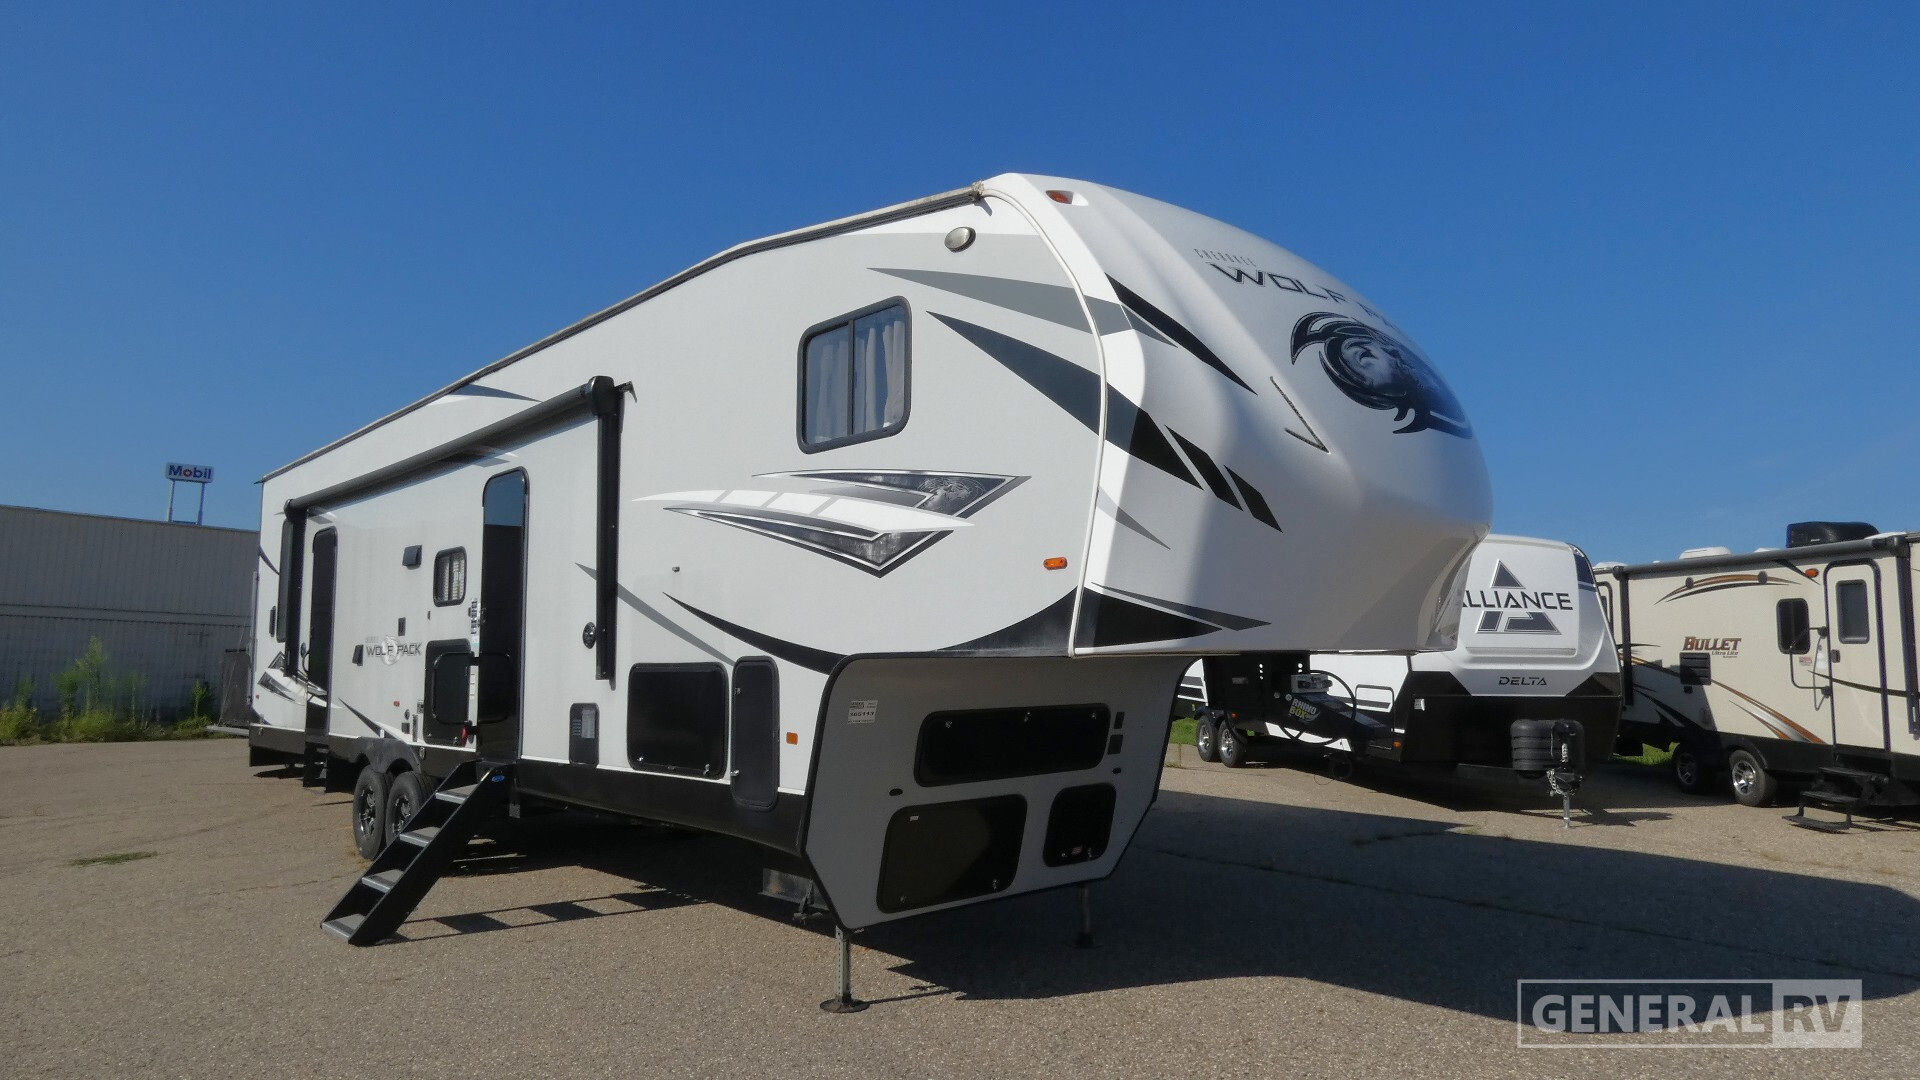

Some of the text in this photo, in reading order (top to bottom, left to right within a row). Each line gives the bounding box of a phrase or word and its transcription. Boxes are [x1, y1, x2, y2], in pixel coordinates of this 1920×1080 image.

[1206, 262, 1347, 304] WOLF
[168, 464, 212, 479] Mobil
[1462, 590, 1574, 611] LLIANCE
[365, 642, 422, 657] WOLF PACK
[1682, 636, 1742, 651] BULLET
[1498, 676, 1547, 686] DELTA
[1290, 705, 1308, 719] BOX
[1292, 698, 1317, 715] RHINO
